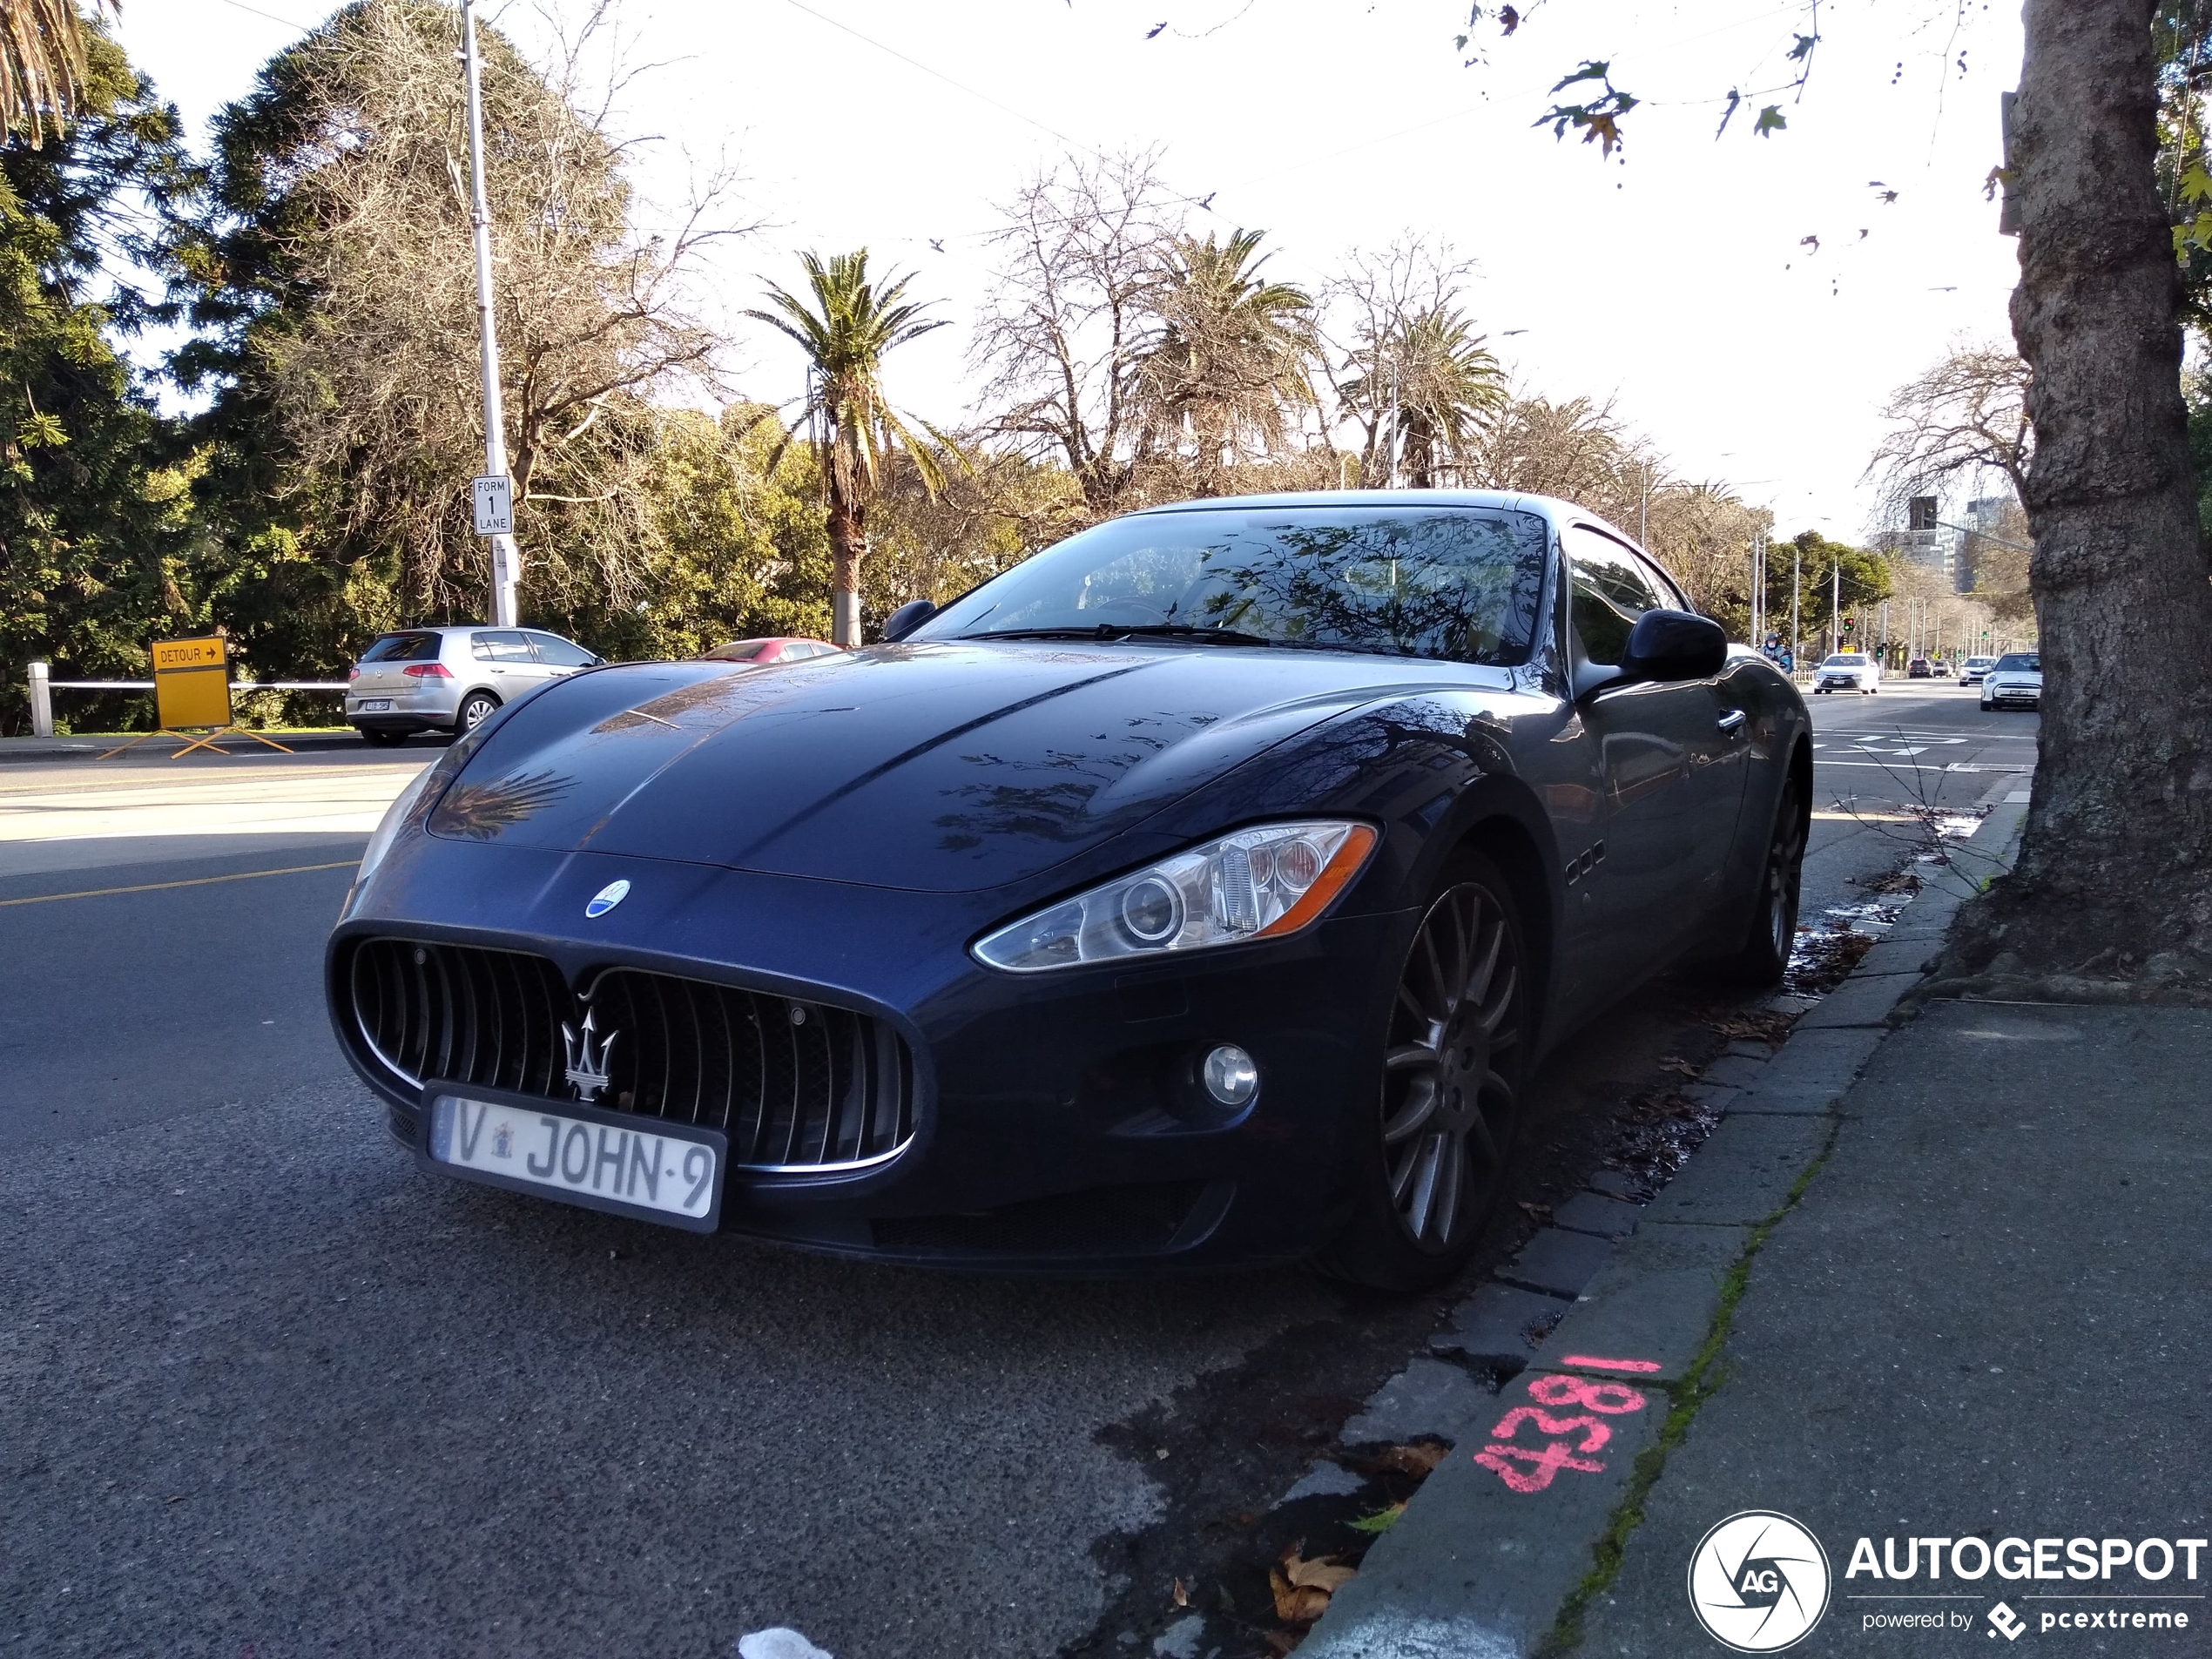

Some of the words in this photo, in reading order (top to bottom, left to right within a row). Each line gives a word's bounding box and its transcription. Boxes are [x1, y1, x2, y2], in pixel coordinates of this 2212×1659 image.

[477, 481, 505, 492] FORM
[488, 496, 495, 515] 1
[480, 518, 507, 529] LANE
[160, 648, 201, 663] DETOUR
[460, 1101, 487, 1161] V
[1474, 1355, 1662, 1493] 4381
